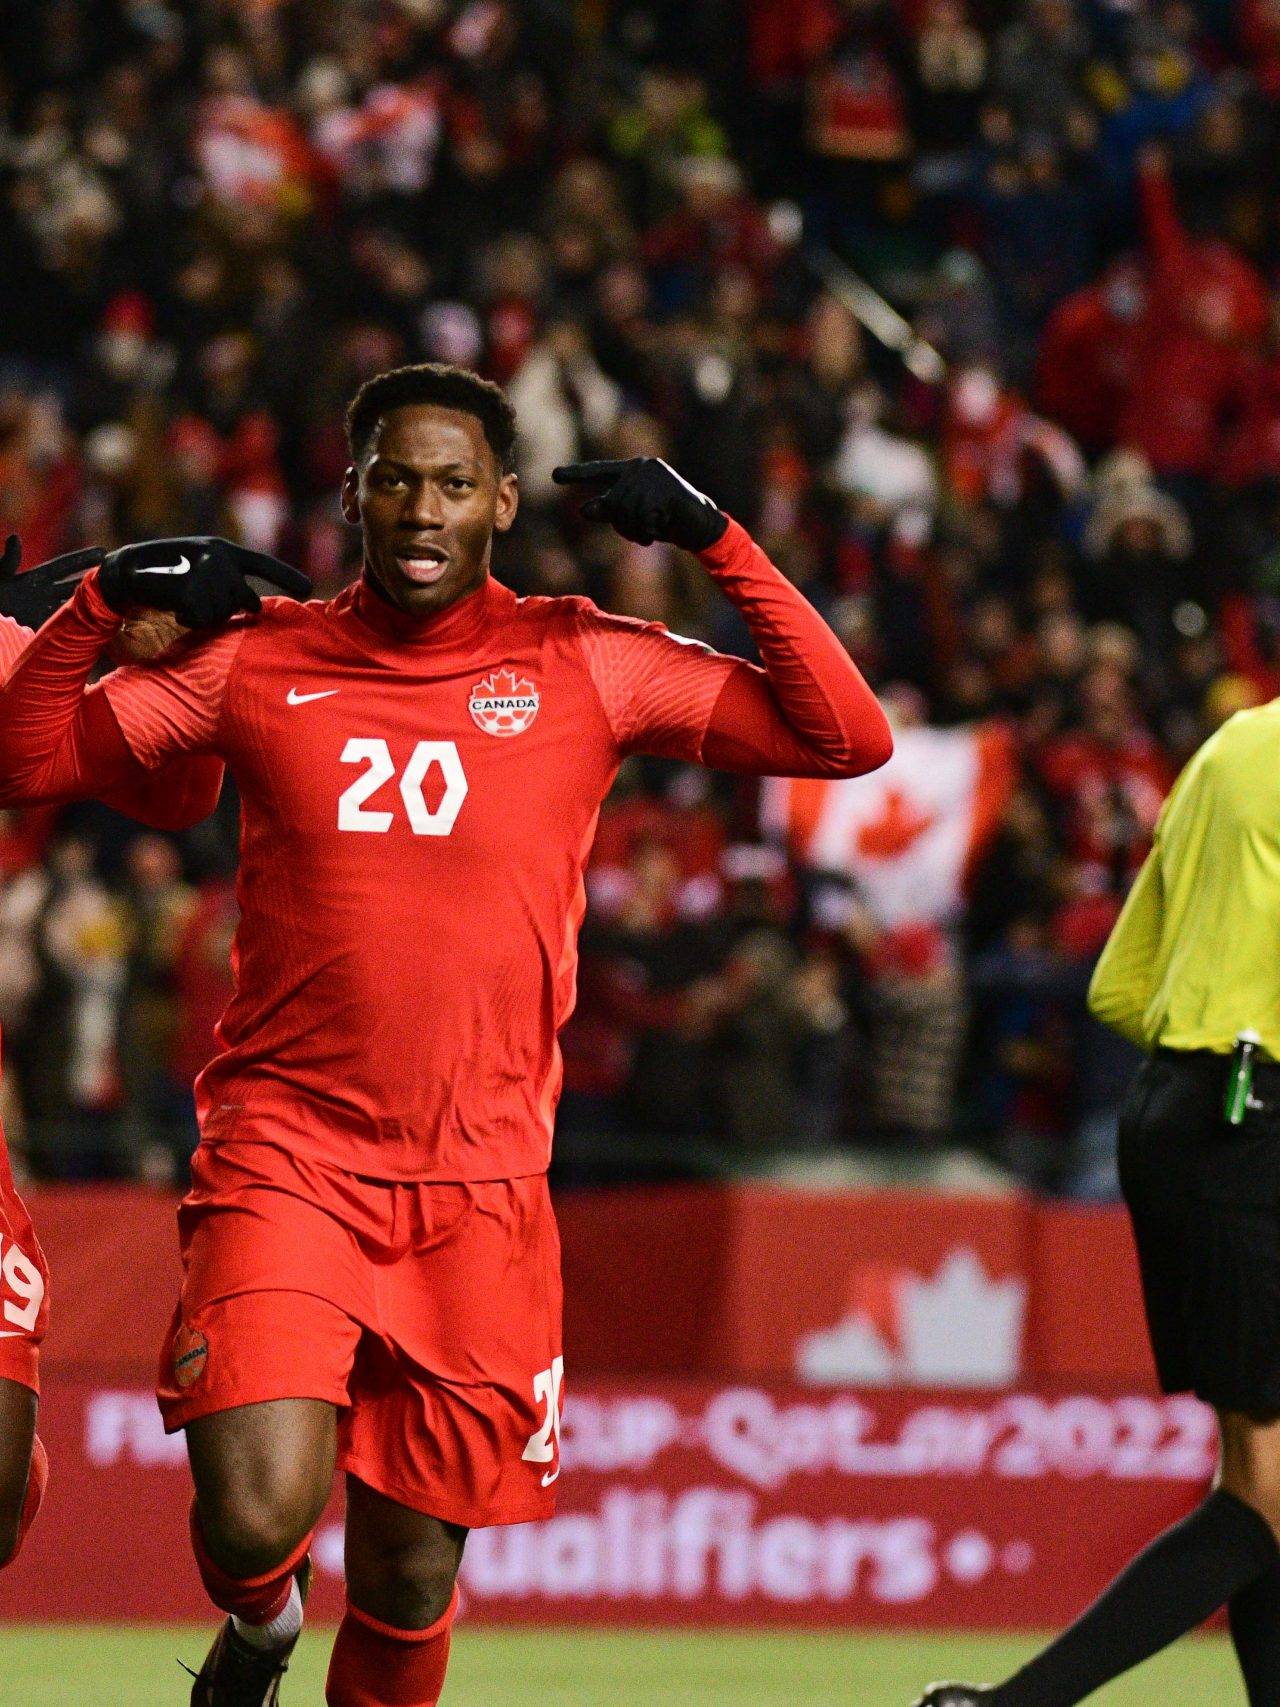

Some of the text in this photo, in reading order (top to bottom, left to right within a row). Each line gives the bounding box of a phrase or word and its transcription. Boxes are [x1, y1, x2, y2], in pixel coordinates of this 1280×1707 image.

[472, 699, 536, 710] CANADA
[337, 737, 469, 836] 20
[458, 1490, 936, 1608] ualifiers
